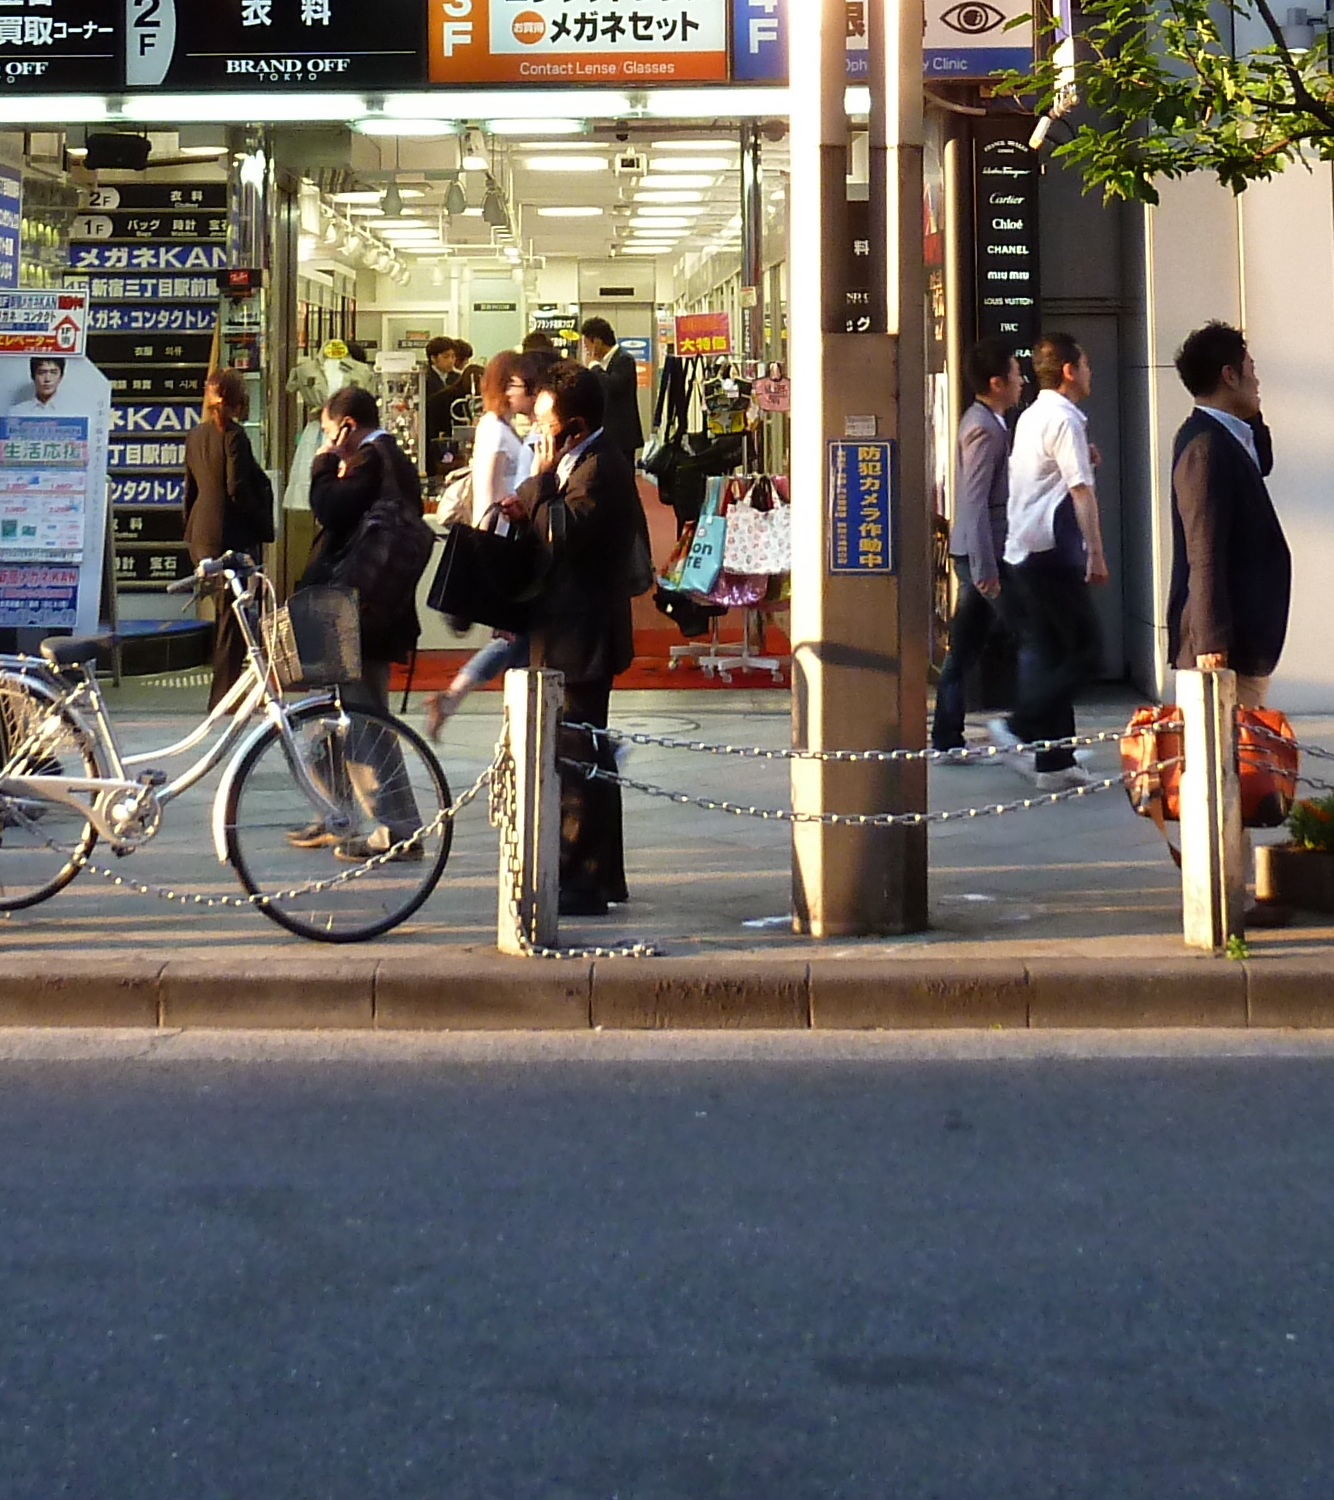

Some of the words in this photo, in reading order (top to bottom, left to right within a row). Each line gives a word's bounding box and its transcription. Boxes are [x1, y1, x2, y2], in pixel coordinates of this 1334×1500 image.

[549, 10, 700, 45] メガネセット
[5, 61, 49, 76] OFF
[226, 59, 302, 74] BRAND
[307, 58, 351, 74] OFF
[520, 61, 573, 75] Contact
[576, 61, 617, 75] Lense
[623, 60, 676, 75] Glasses
[933, 57, 968, 71] Clinic
[258, 73, 318, 81] TOKYO
[89, 192, 112, 207] 2F
[170, 190, 204, 202] 衣料
[990, 192, 1025, 205] Cartier
[84, 219, 105, 235] 1F
[128, 219, 160, 230] バッグ
[173, 219, 196, 231] 時計
[992, 218, 1024, 230] Chloé
[987, 245, 1029, 255] CHANEL
[984, 298, 1003, 306] LOUIS
[1004, 298, 1034, 306] VUITTON
[1000, 323, 1018, 332] IWC
[680, 336, 727, 352] 大特価
[857, 446, 883, 568] 防犯カメラ作動中
[150, 556, 177, 571] 宝石
